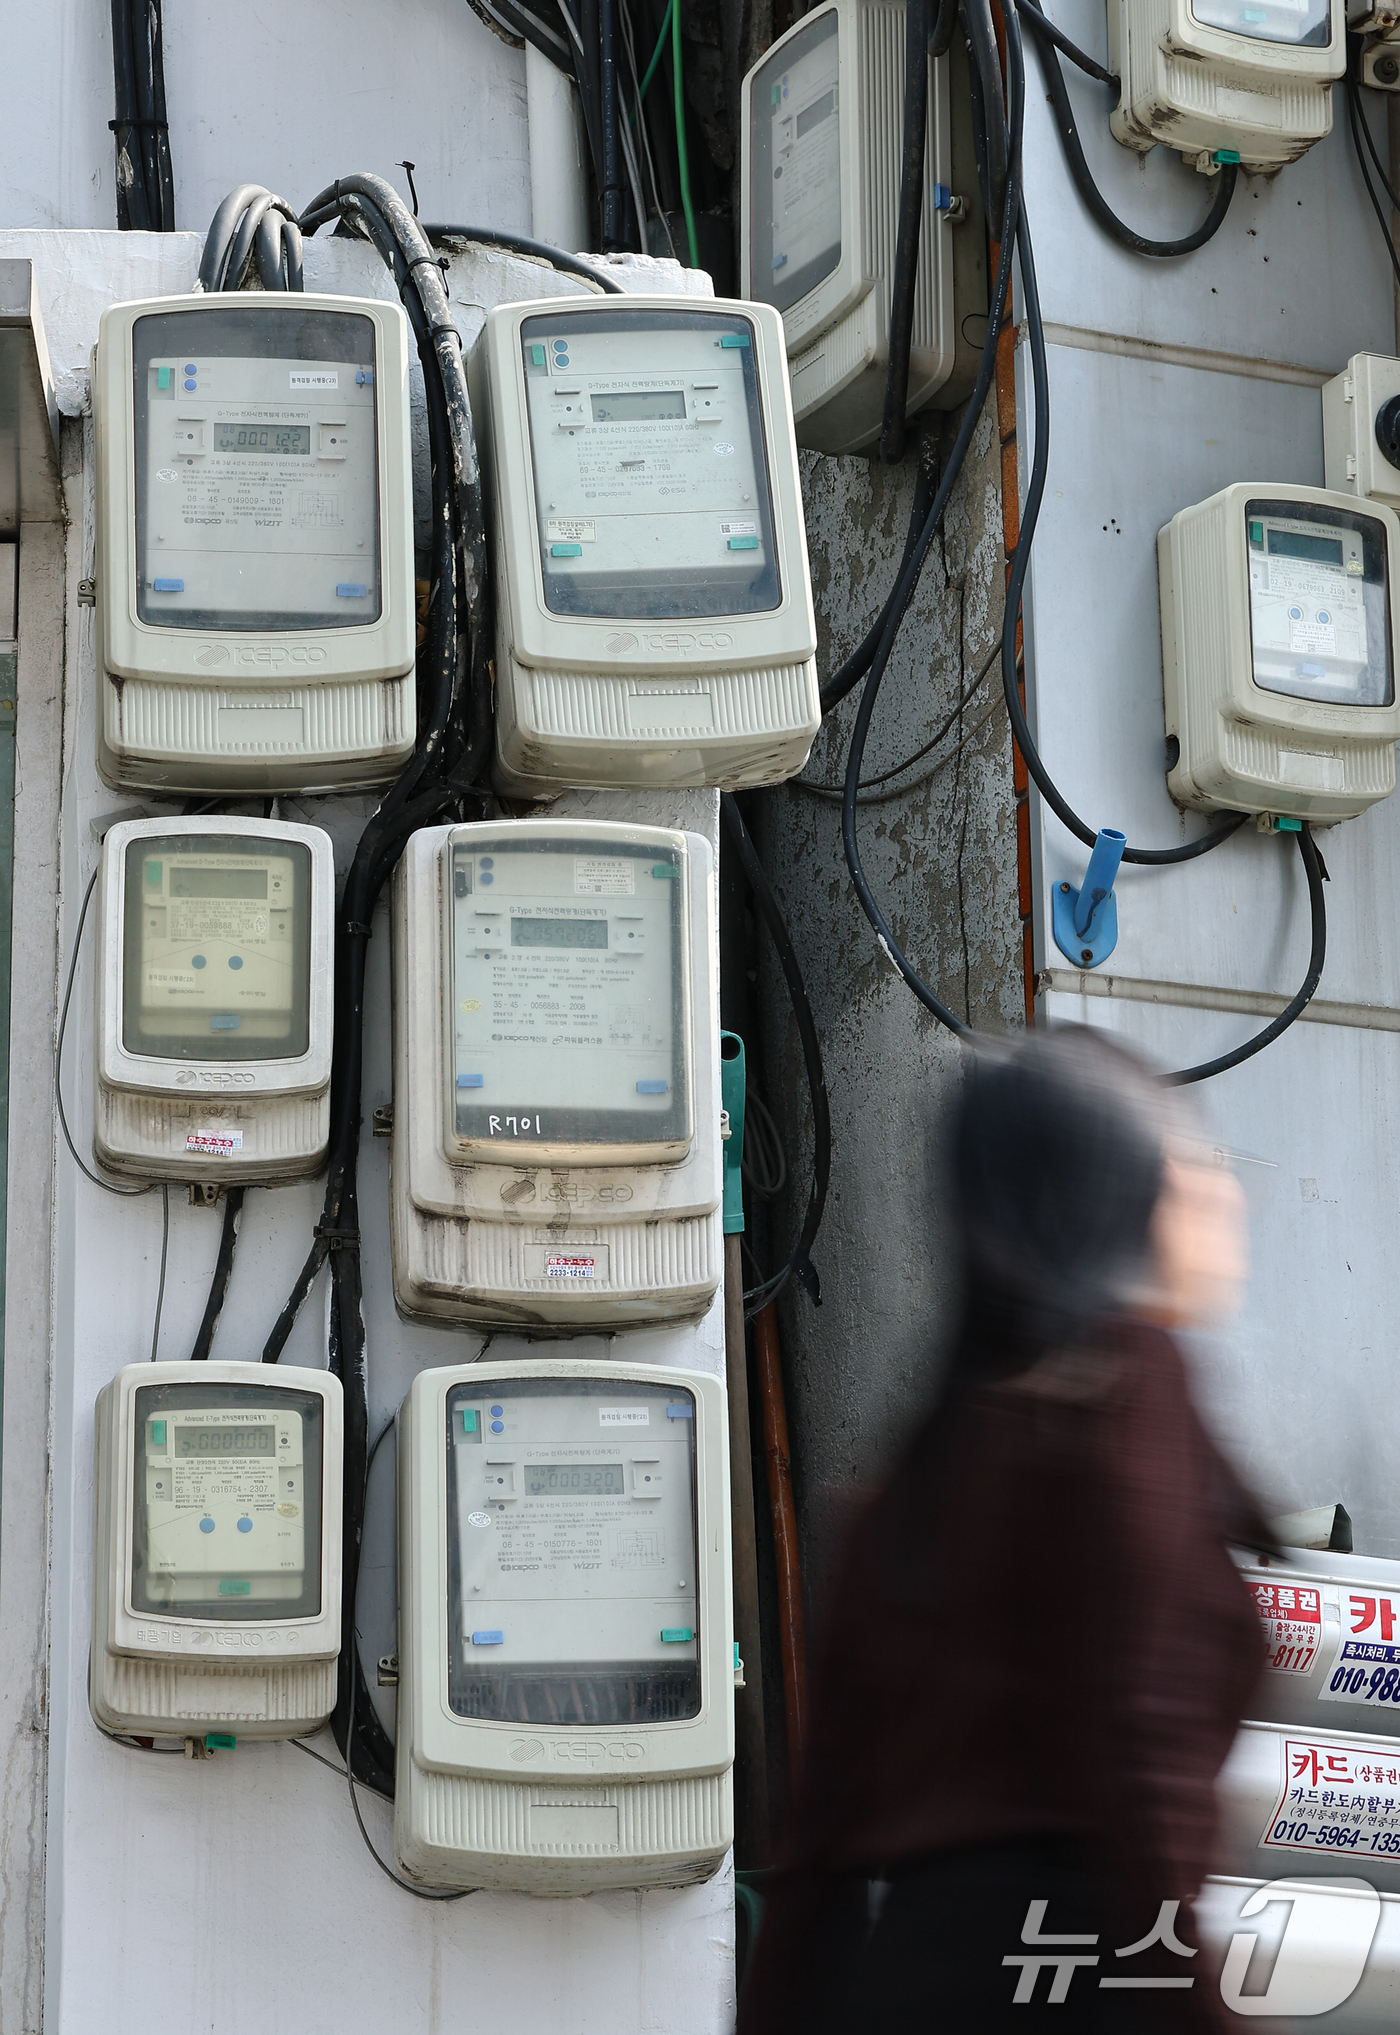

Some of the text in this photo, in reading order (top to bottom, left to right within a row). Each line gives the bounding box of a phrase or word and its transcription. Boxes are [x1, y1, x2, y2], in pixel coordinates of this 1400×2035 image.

[269, 497, 284, 505] 1801
[569, 1003, 585, 1011] 2008
[489, 1114, 541, 1135] R701
[550, 1269, 586, 1277] 2233-1214
[549, 1472, 613, 1487] 0003.20
[250, 1485, 268, 1493] 2307
[544, 1540, 576, 1548] 0150776
[573, 1562, 602, 1570] WIZIT
[1345, 1643, 1389, 1661] 즉시처리,
[1292, 1748, 1354, 1787] 카드
[1273, 1820, 1400, 1853] 010-5964-135
